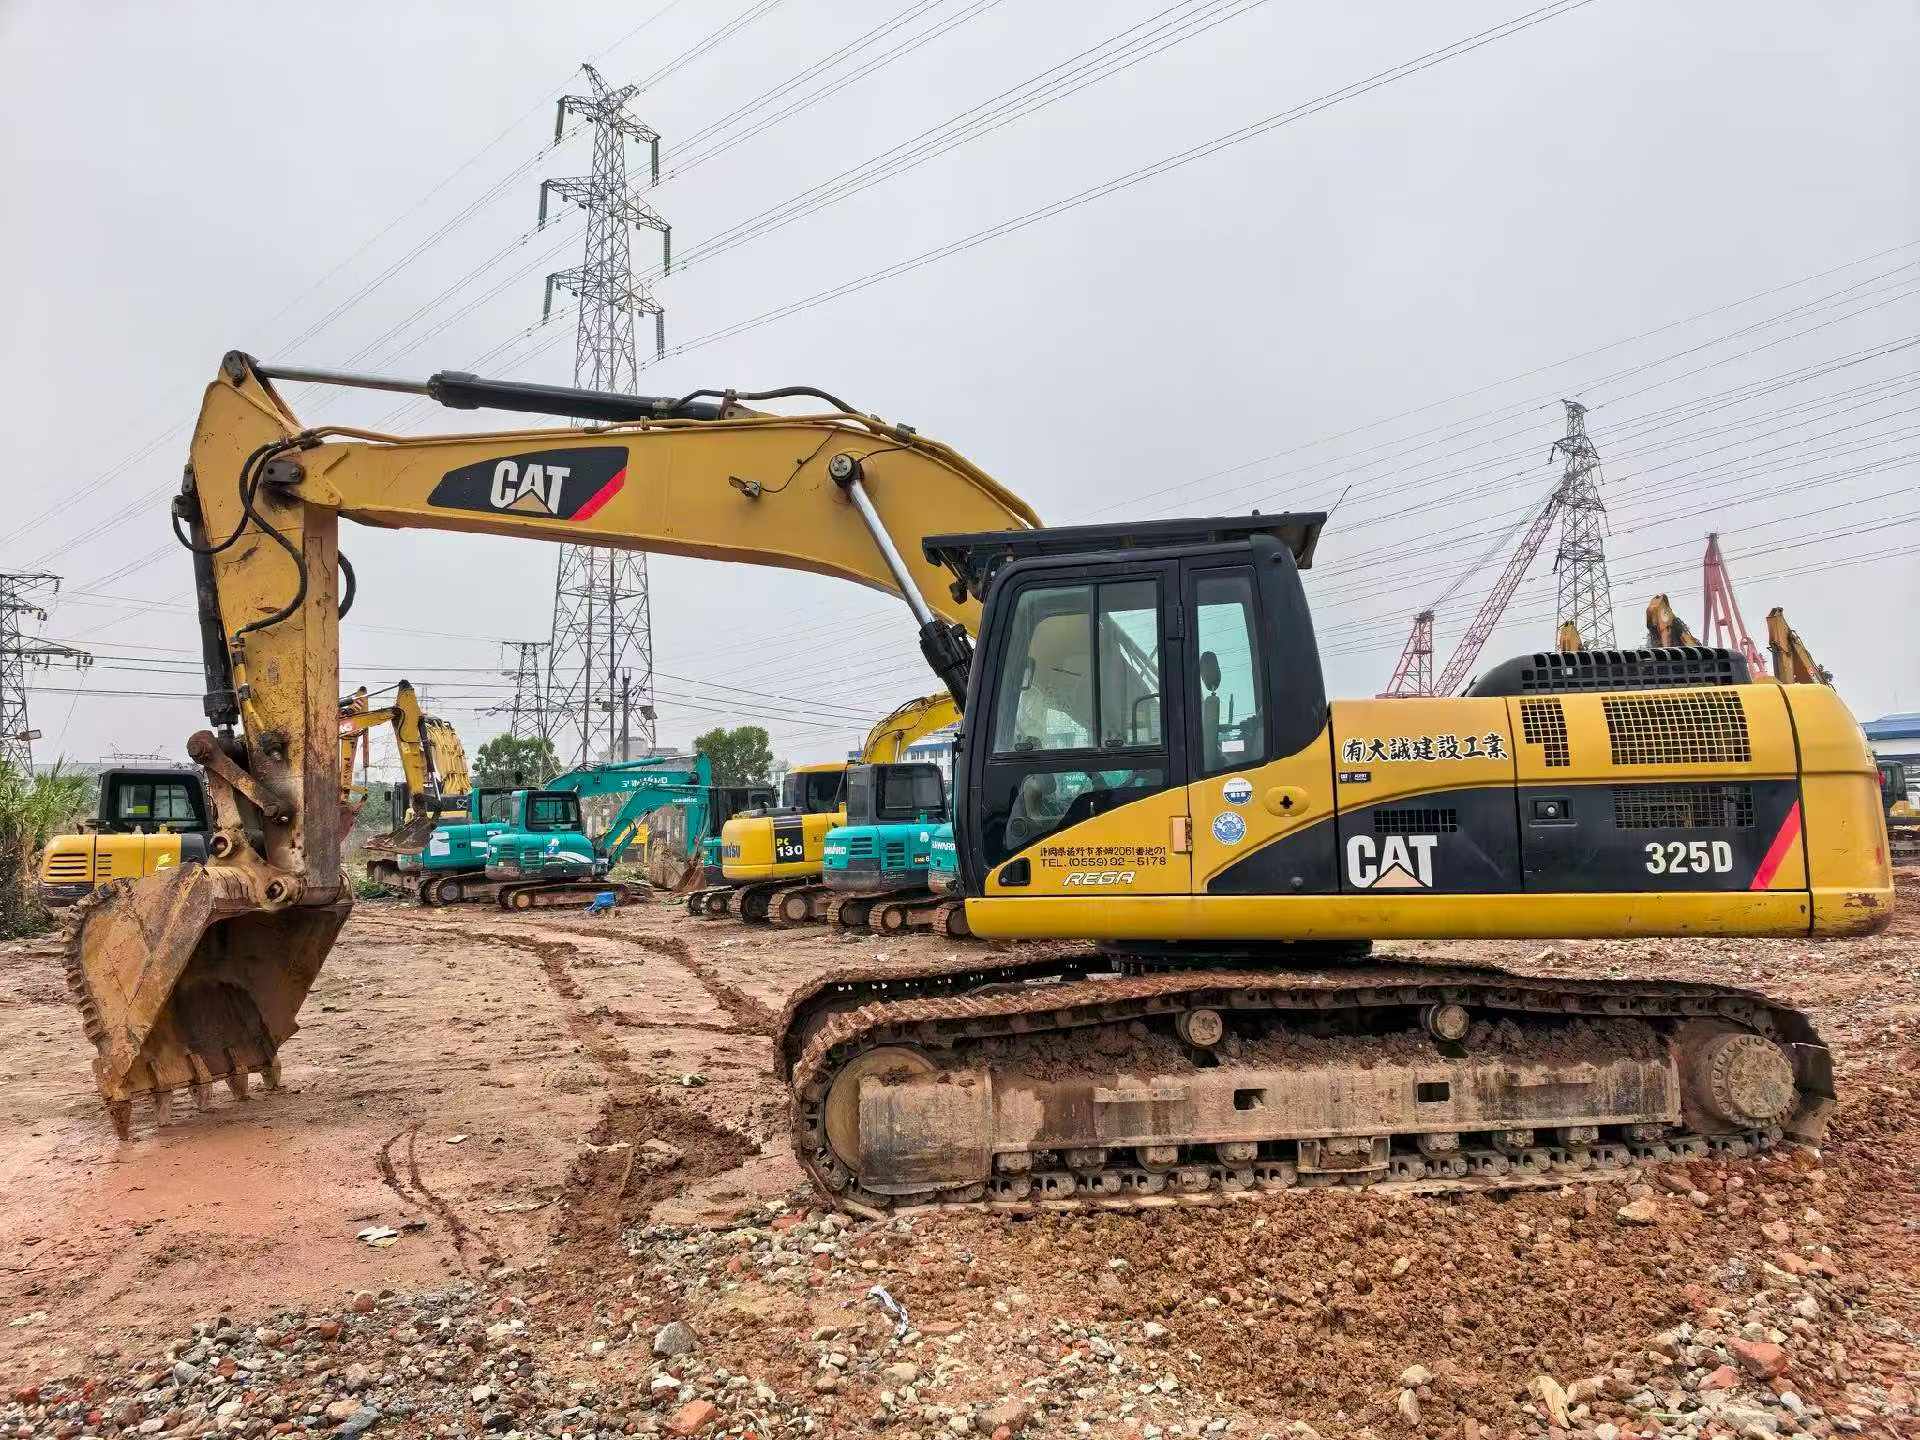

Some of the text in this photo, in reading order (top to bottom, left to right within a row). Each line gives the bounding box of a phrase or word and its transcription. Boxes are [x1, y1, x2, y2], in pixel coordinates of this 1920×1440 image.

[490, 460, 571, 515] CAT
[776, 838, 789, 847] PC
[777, 845, 803, 857] 130
[1346, 834, 1438, 888] CAT
[1645, 840, 1733, 875] 325D
[1063, 870, 1136, 886] REGA
